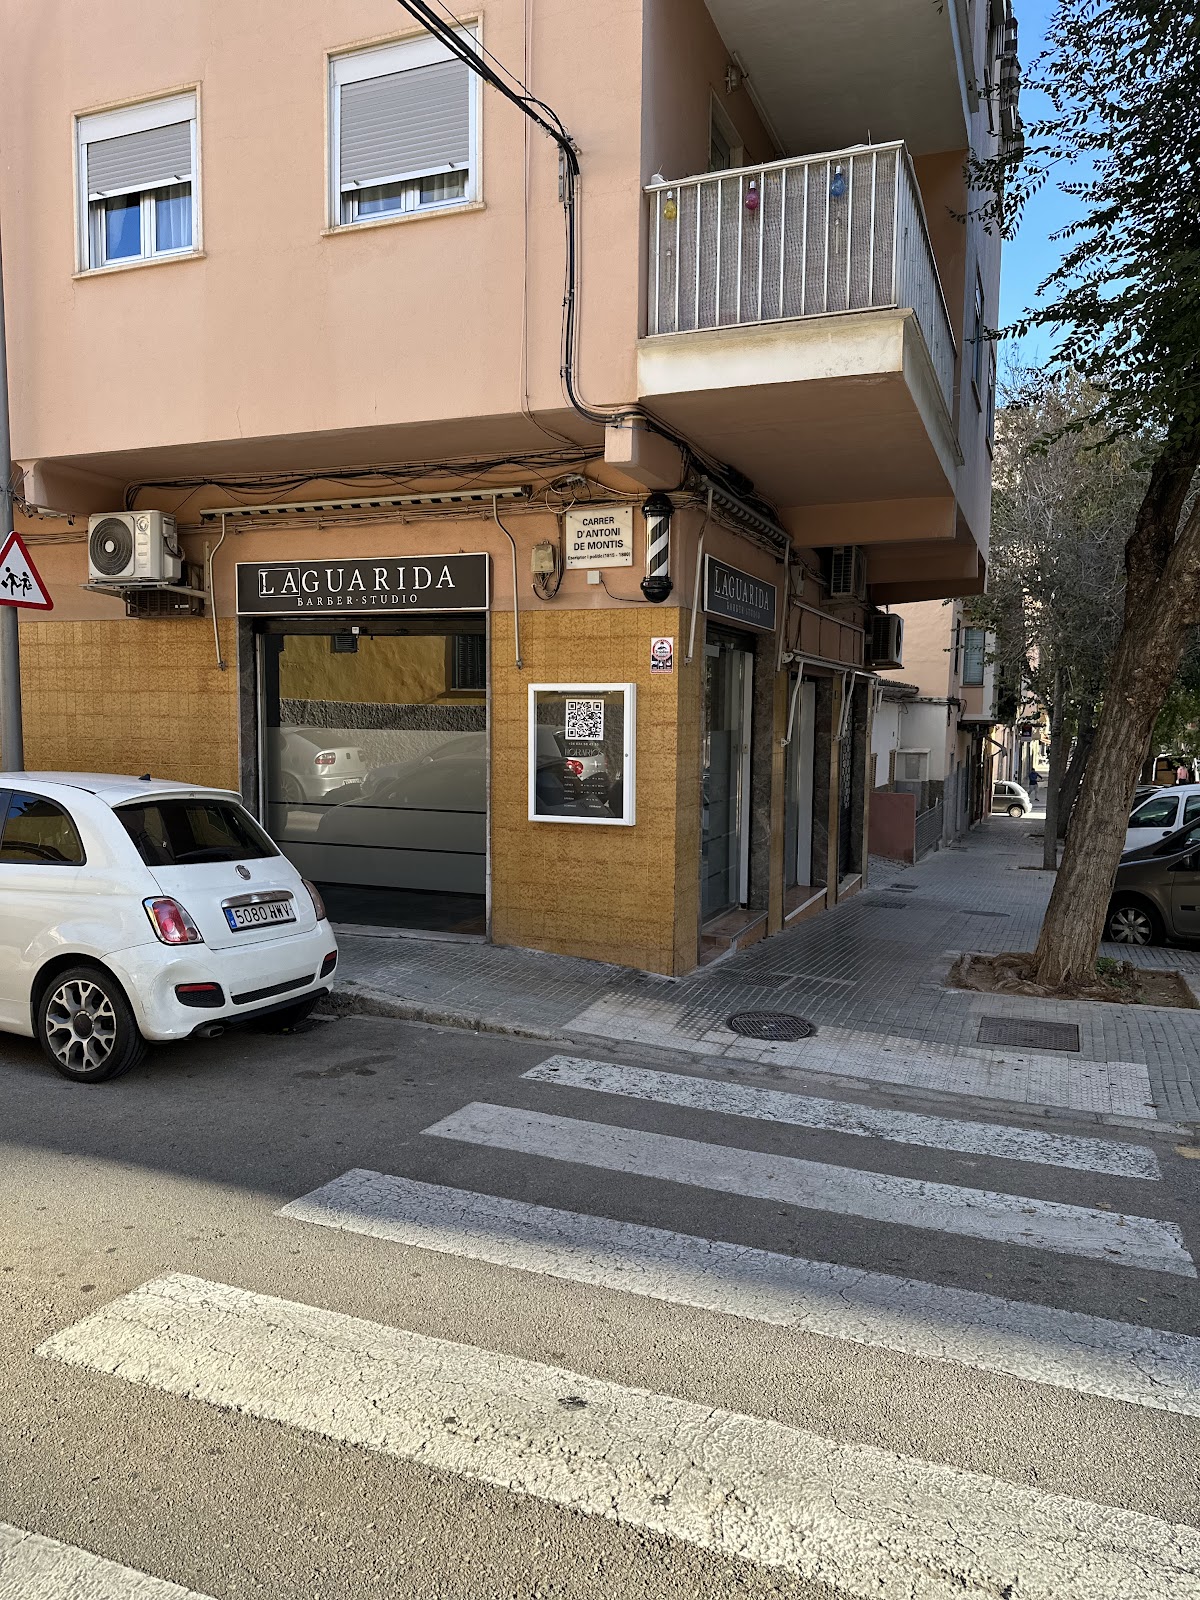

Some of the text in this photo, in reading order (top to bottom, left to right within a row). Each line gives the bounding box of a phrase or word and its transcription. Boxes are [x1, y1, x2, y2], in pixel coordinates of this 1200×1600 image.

[583, 517, 614, 526] CARRER
[577, 528, 620, 538] D'ANTONI
[588, 540, 623, 549] MONTIS
[234, 906, 268, 924] 5080
